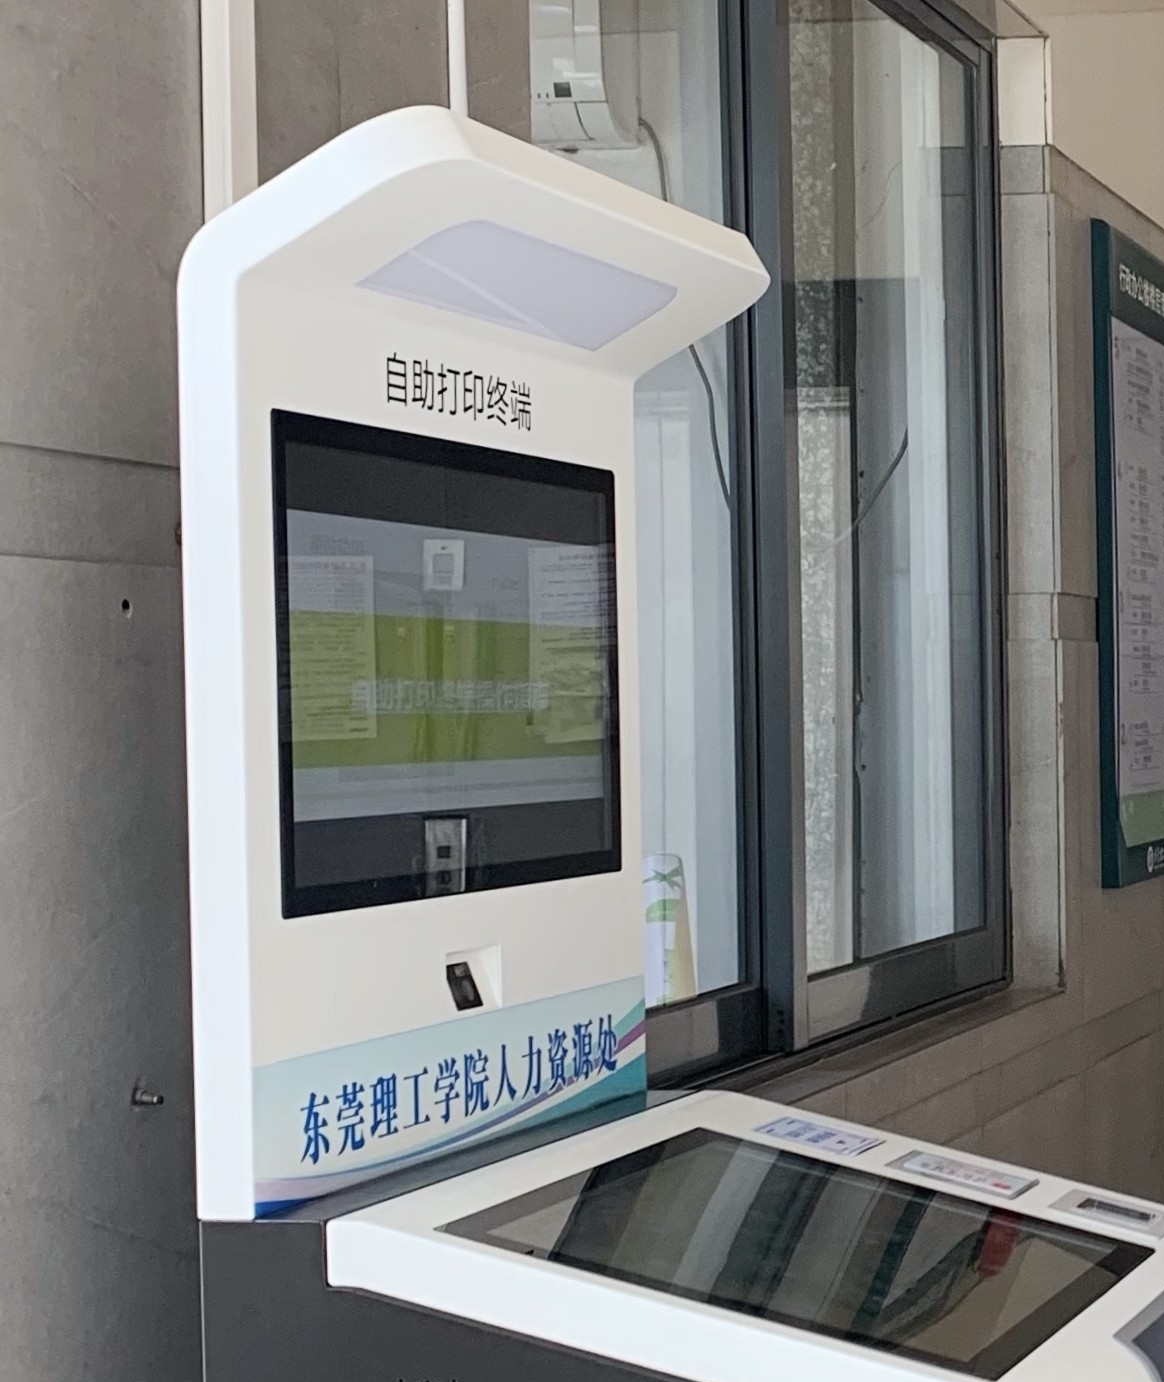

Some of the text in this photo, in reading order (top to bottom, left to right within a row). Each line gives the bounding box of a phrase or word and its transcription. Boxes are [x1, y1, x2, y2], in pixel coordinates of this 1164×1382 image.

[386, 352, 532, 431] 自助打印终端
[300, 1014, 619, 1165] 东莞理工学院人力资源处
